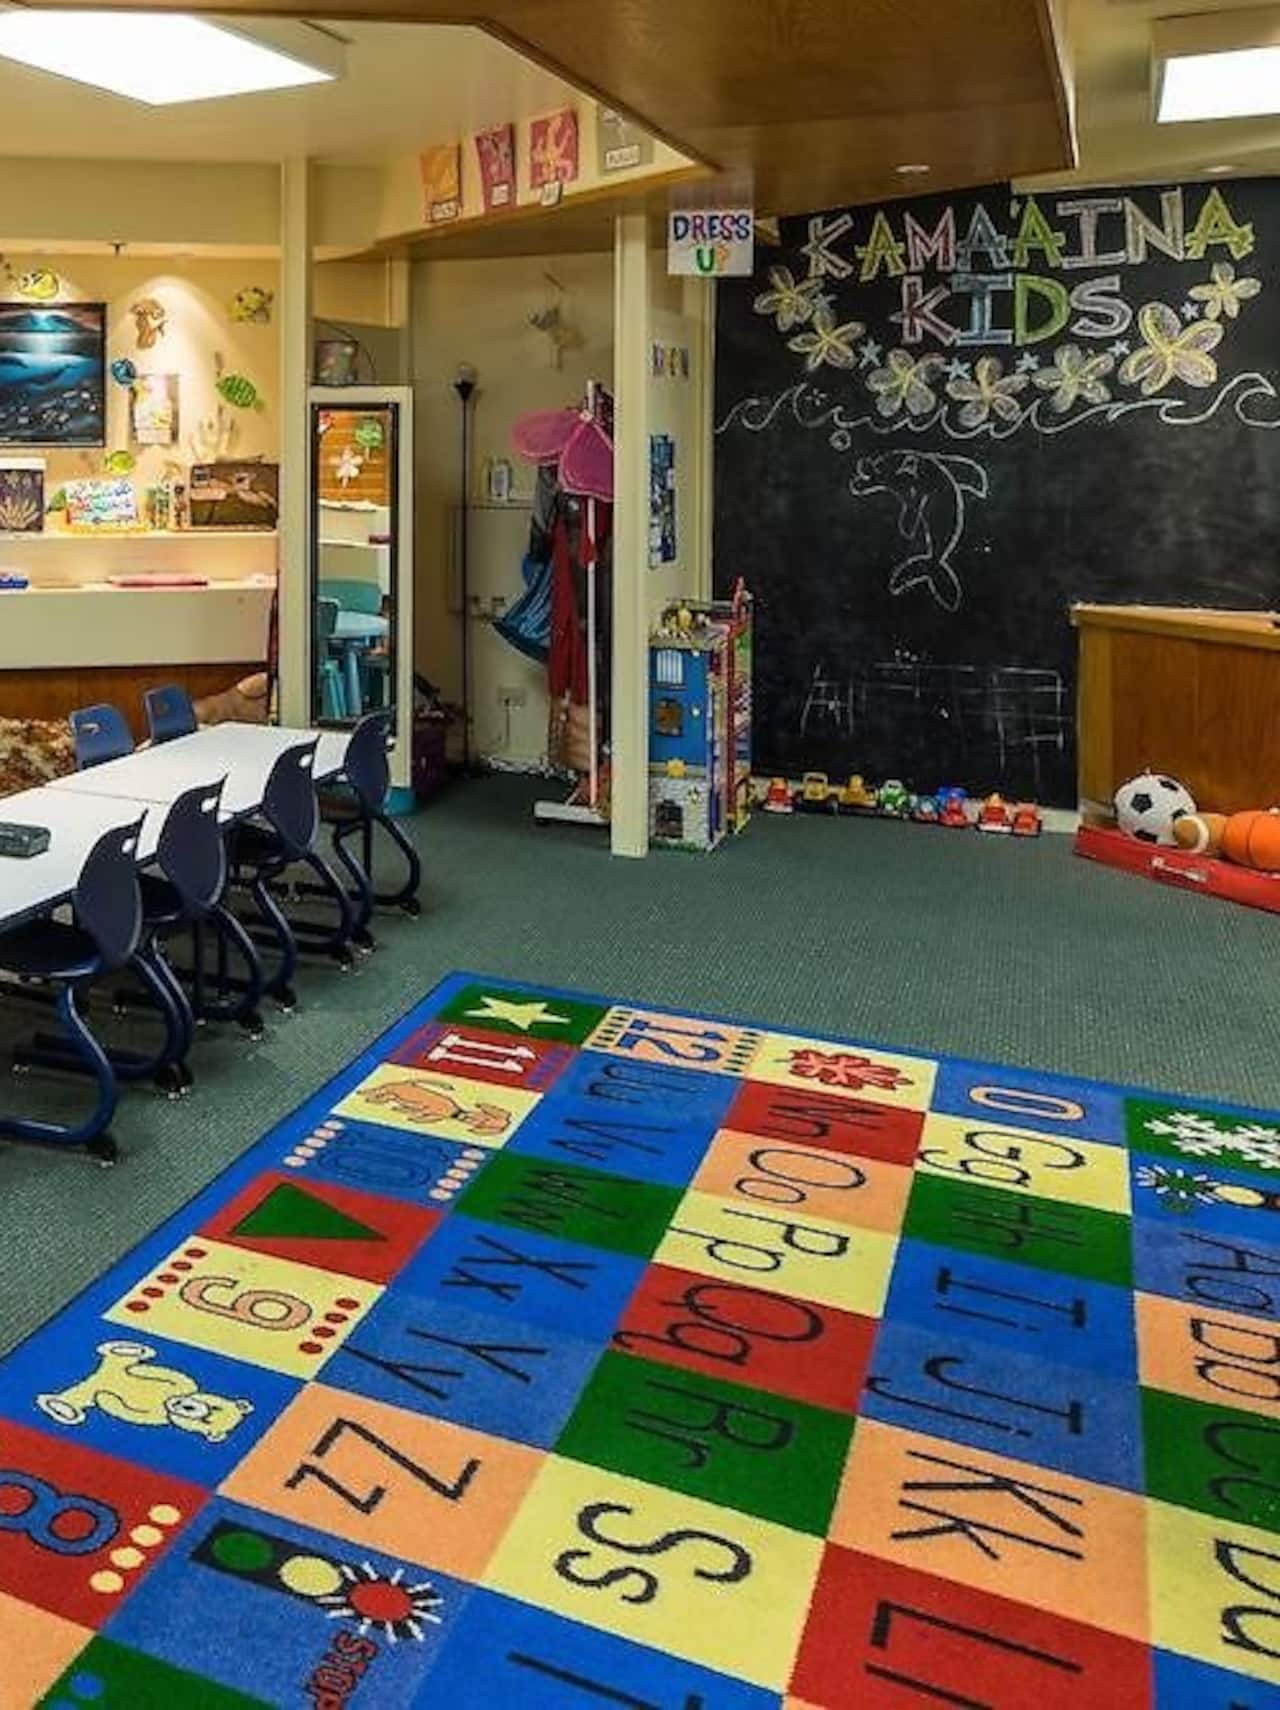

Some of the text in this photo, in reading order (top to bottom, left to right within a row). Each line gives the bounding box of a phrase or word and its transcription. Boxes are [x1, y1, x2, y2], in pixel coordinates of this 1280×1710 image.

[673, 214, 750, 241] DRESS
[892, 272, 1133, 346] KIDS
[427, 1032, 538, 1074] 11
[616, 1018, 729, 1064] 12
[919, 1130, 1087, 1188] Gg
[668, 1207, 851, 1272] Pp
[612, 1283, 824, 1367] Qq
[624, 1378, 795, 1469] Rr
[866, 1356, 1085, 1438] Jj
[284, 1417, 483, 1516] Zz
[889, 1449, 1085, 1560] Kk
[553, 1502, 752, 1604] Ss
